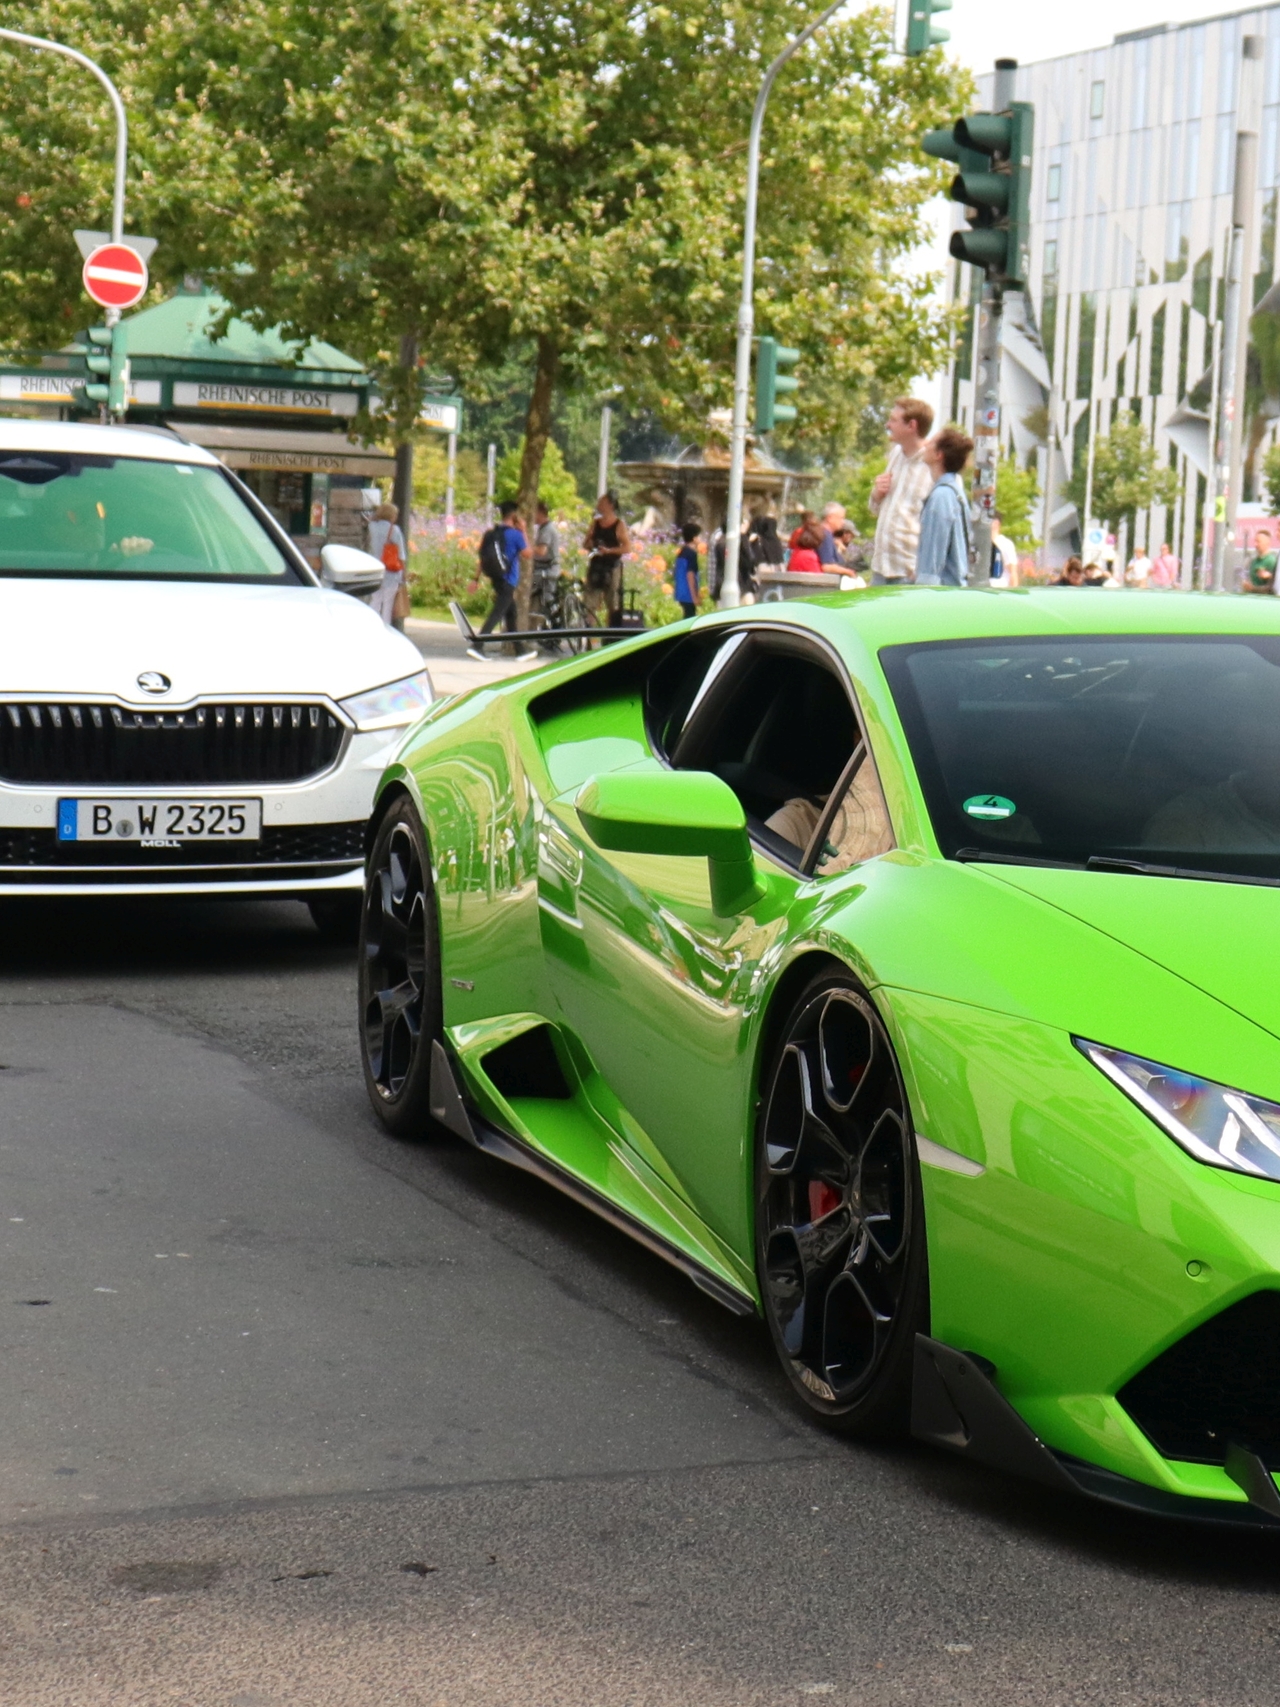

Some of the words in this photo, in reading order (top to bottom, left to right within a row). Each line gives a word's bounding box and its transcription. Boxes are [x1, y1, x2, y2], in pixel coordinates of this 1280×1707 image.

[20, 377, 87, 394] RHEINISC
[197, 384, 287, 405] RHEINISCHE
[292, 391, 332, 408] POST
[250, 452, 313, 467] RHEINISCHE
[317, 456, 347, 469] POST
[983, 796, 998, 807] 4
[93, 805, 112, 835] B
[138, 805, 157, 835] W
[166, 805, 246, 835] 2325
[141, 840, 181, 848] MOLL
